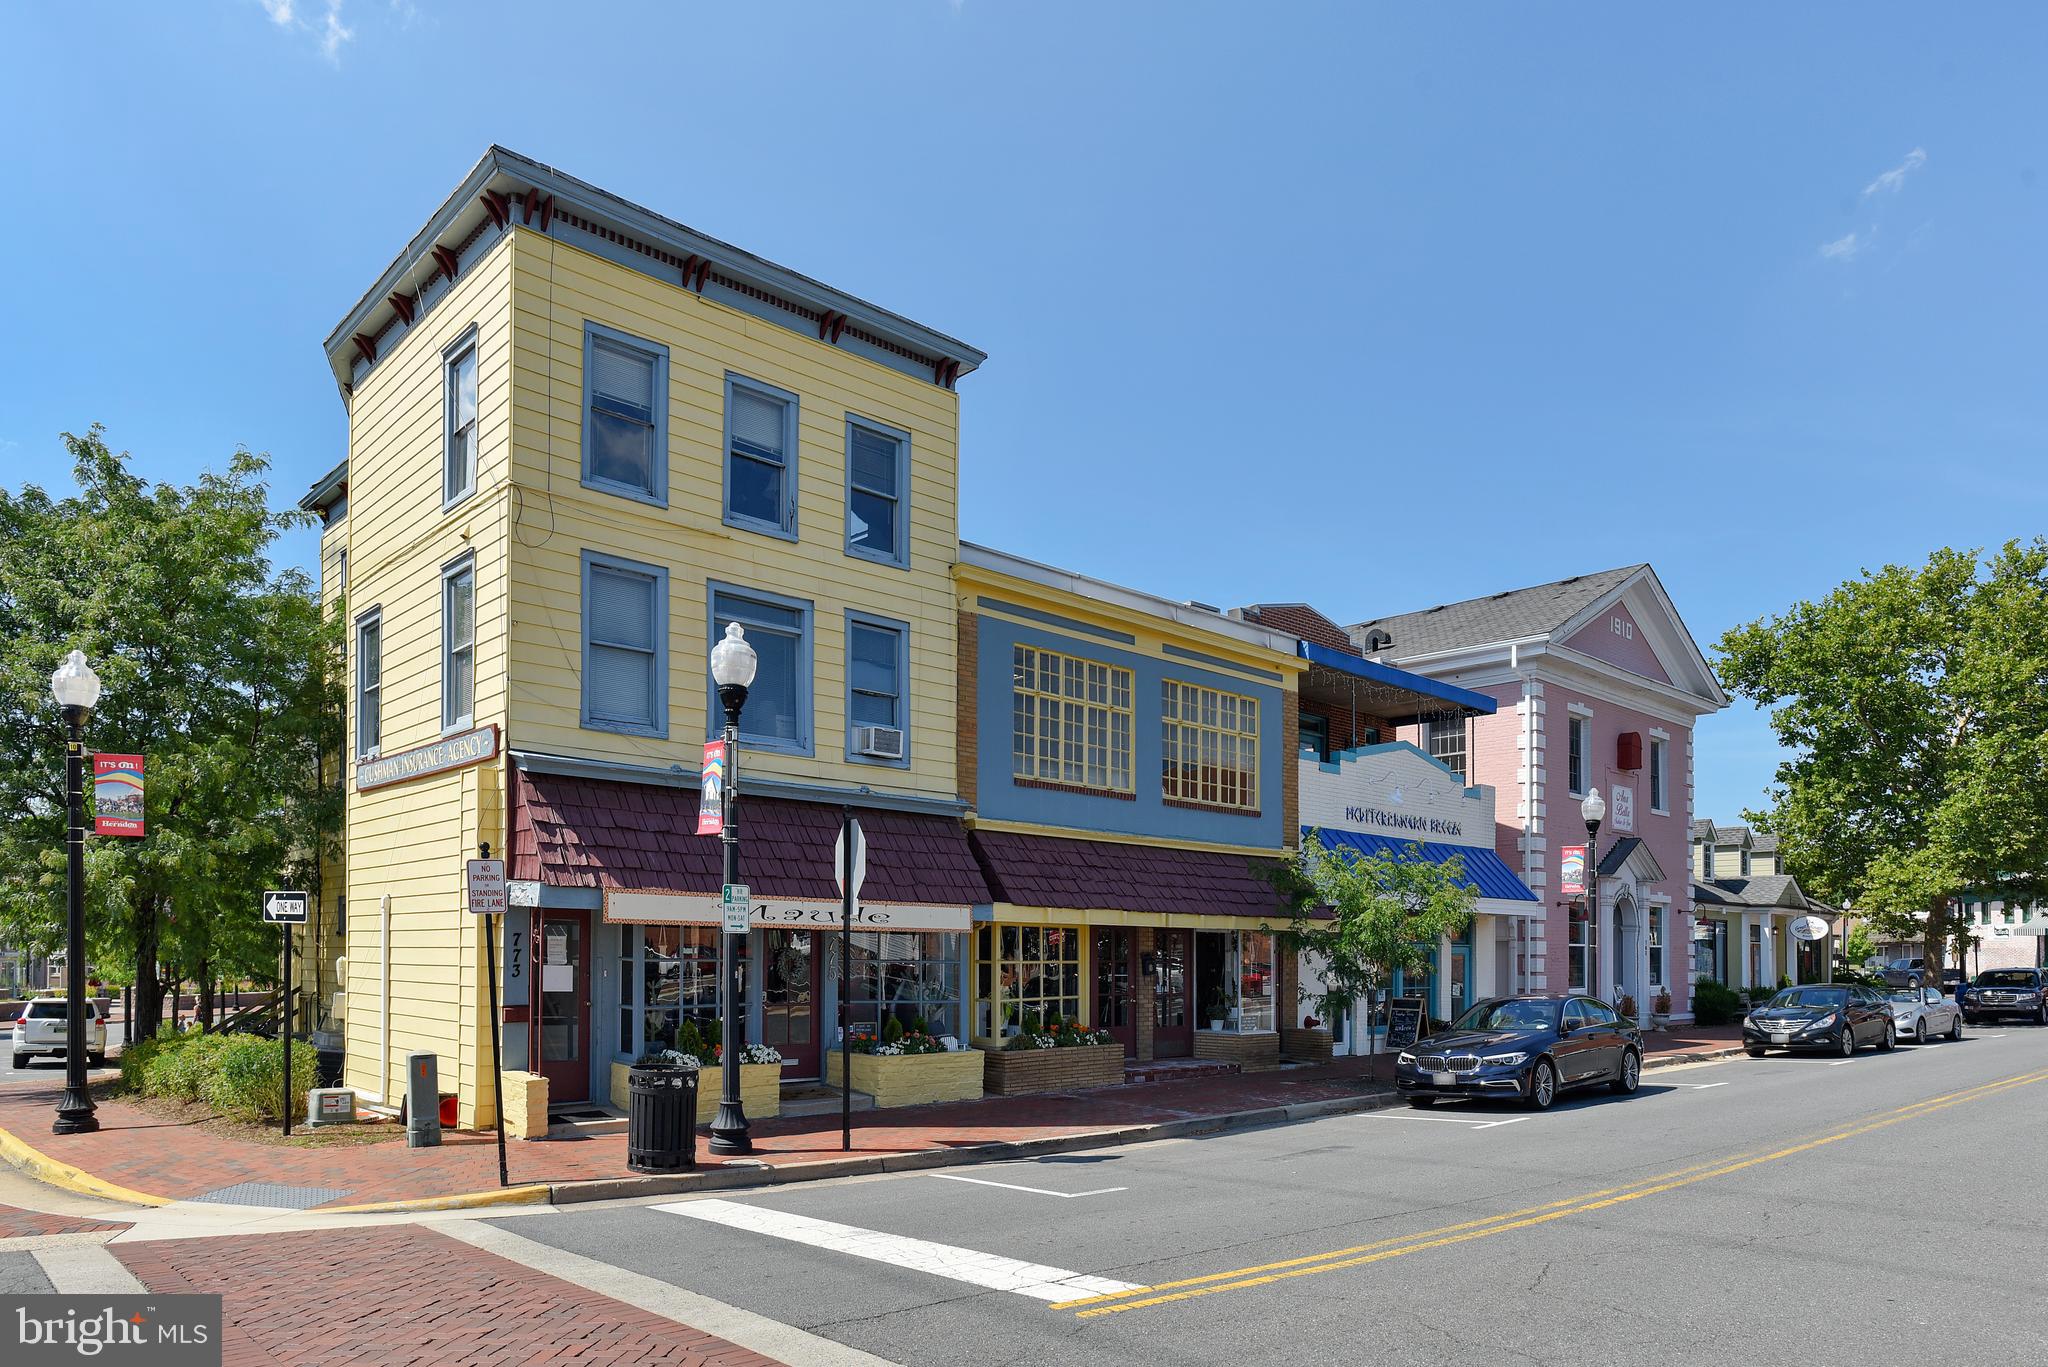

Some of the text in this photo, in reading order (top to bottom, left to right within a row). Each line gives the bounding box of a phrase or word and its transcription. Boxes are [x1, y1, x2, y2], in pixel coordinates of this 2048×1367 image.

[1610, 615, 1632, 640] 1910
[364, 734, 483, 784] CUSHMAN INSURANCE AGENCY
[100, 761, 116, 769] IT'S
[102, 820, 138, 829] Herndon
[1346, 806, 1462, 836] MEDITERRANEAN BREEZE
[481, 865, 491, 873] NO
[471, 889, 503, 897] STANDING
[725, 888, 731, 901] 2
[277, 901, 302, 912] ONE WAY
[471, 898, 505, 908] FIRE LANE
[511, 932, 522, 978] 773
